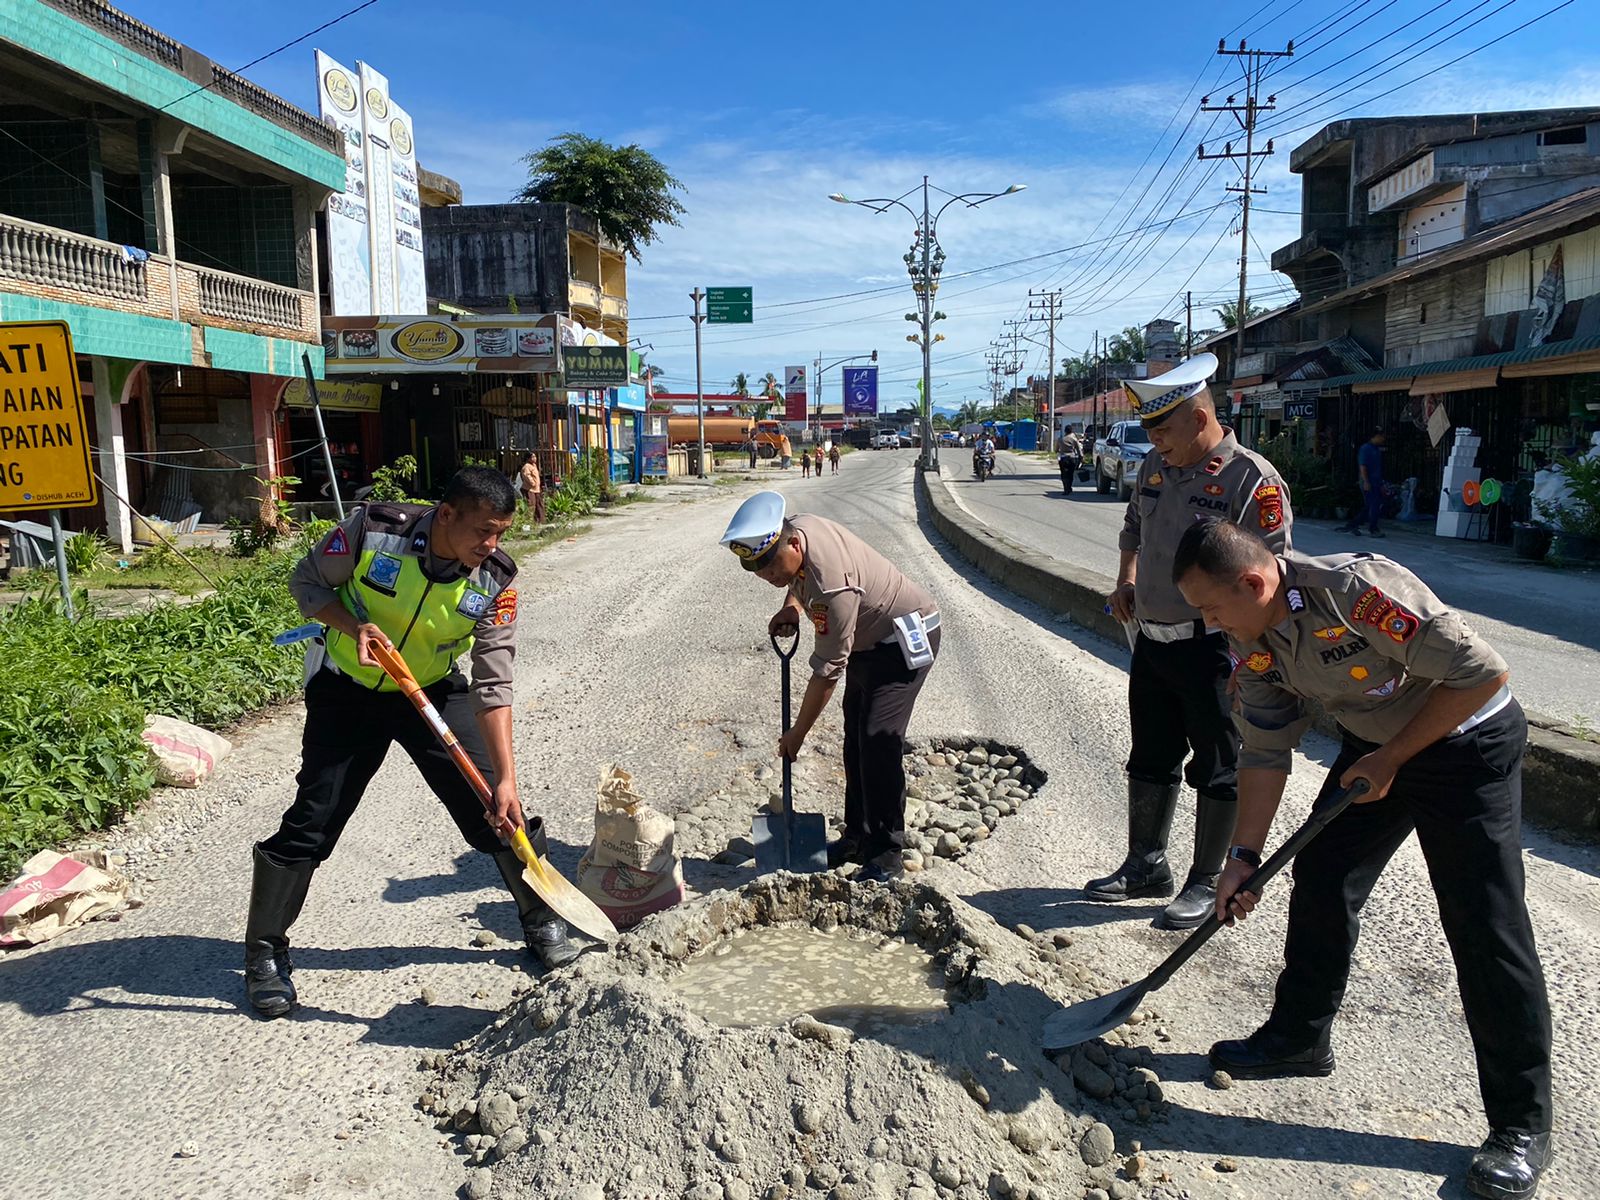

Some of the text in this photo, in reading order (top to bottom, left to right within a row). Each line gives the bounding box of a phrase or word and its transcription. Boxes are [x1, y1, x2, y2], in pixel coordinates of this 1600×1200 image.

[566, 356, 626, 370] YUMNA
[1288, 404, 1314, 416] MTC
[36, 491, 85, 501] DISHUB ACEH
[1188, 495, 1228, 512] POLRI
[1353, 589, 1377, 620] POLRES
[1371, 603, 1388, 622] ACEH
[1320, 637, 1370, 665] POLRI
